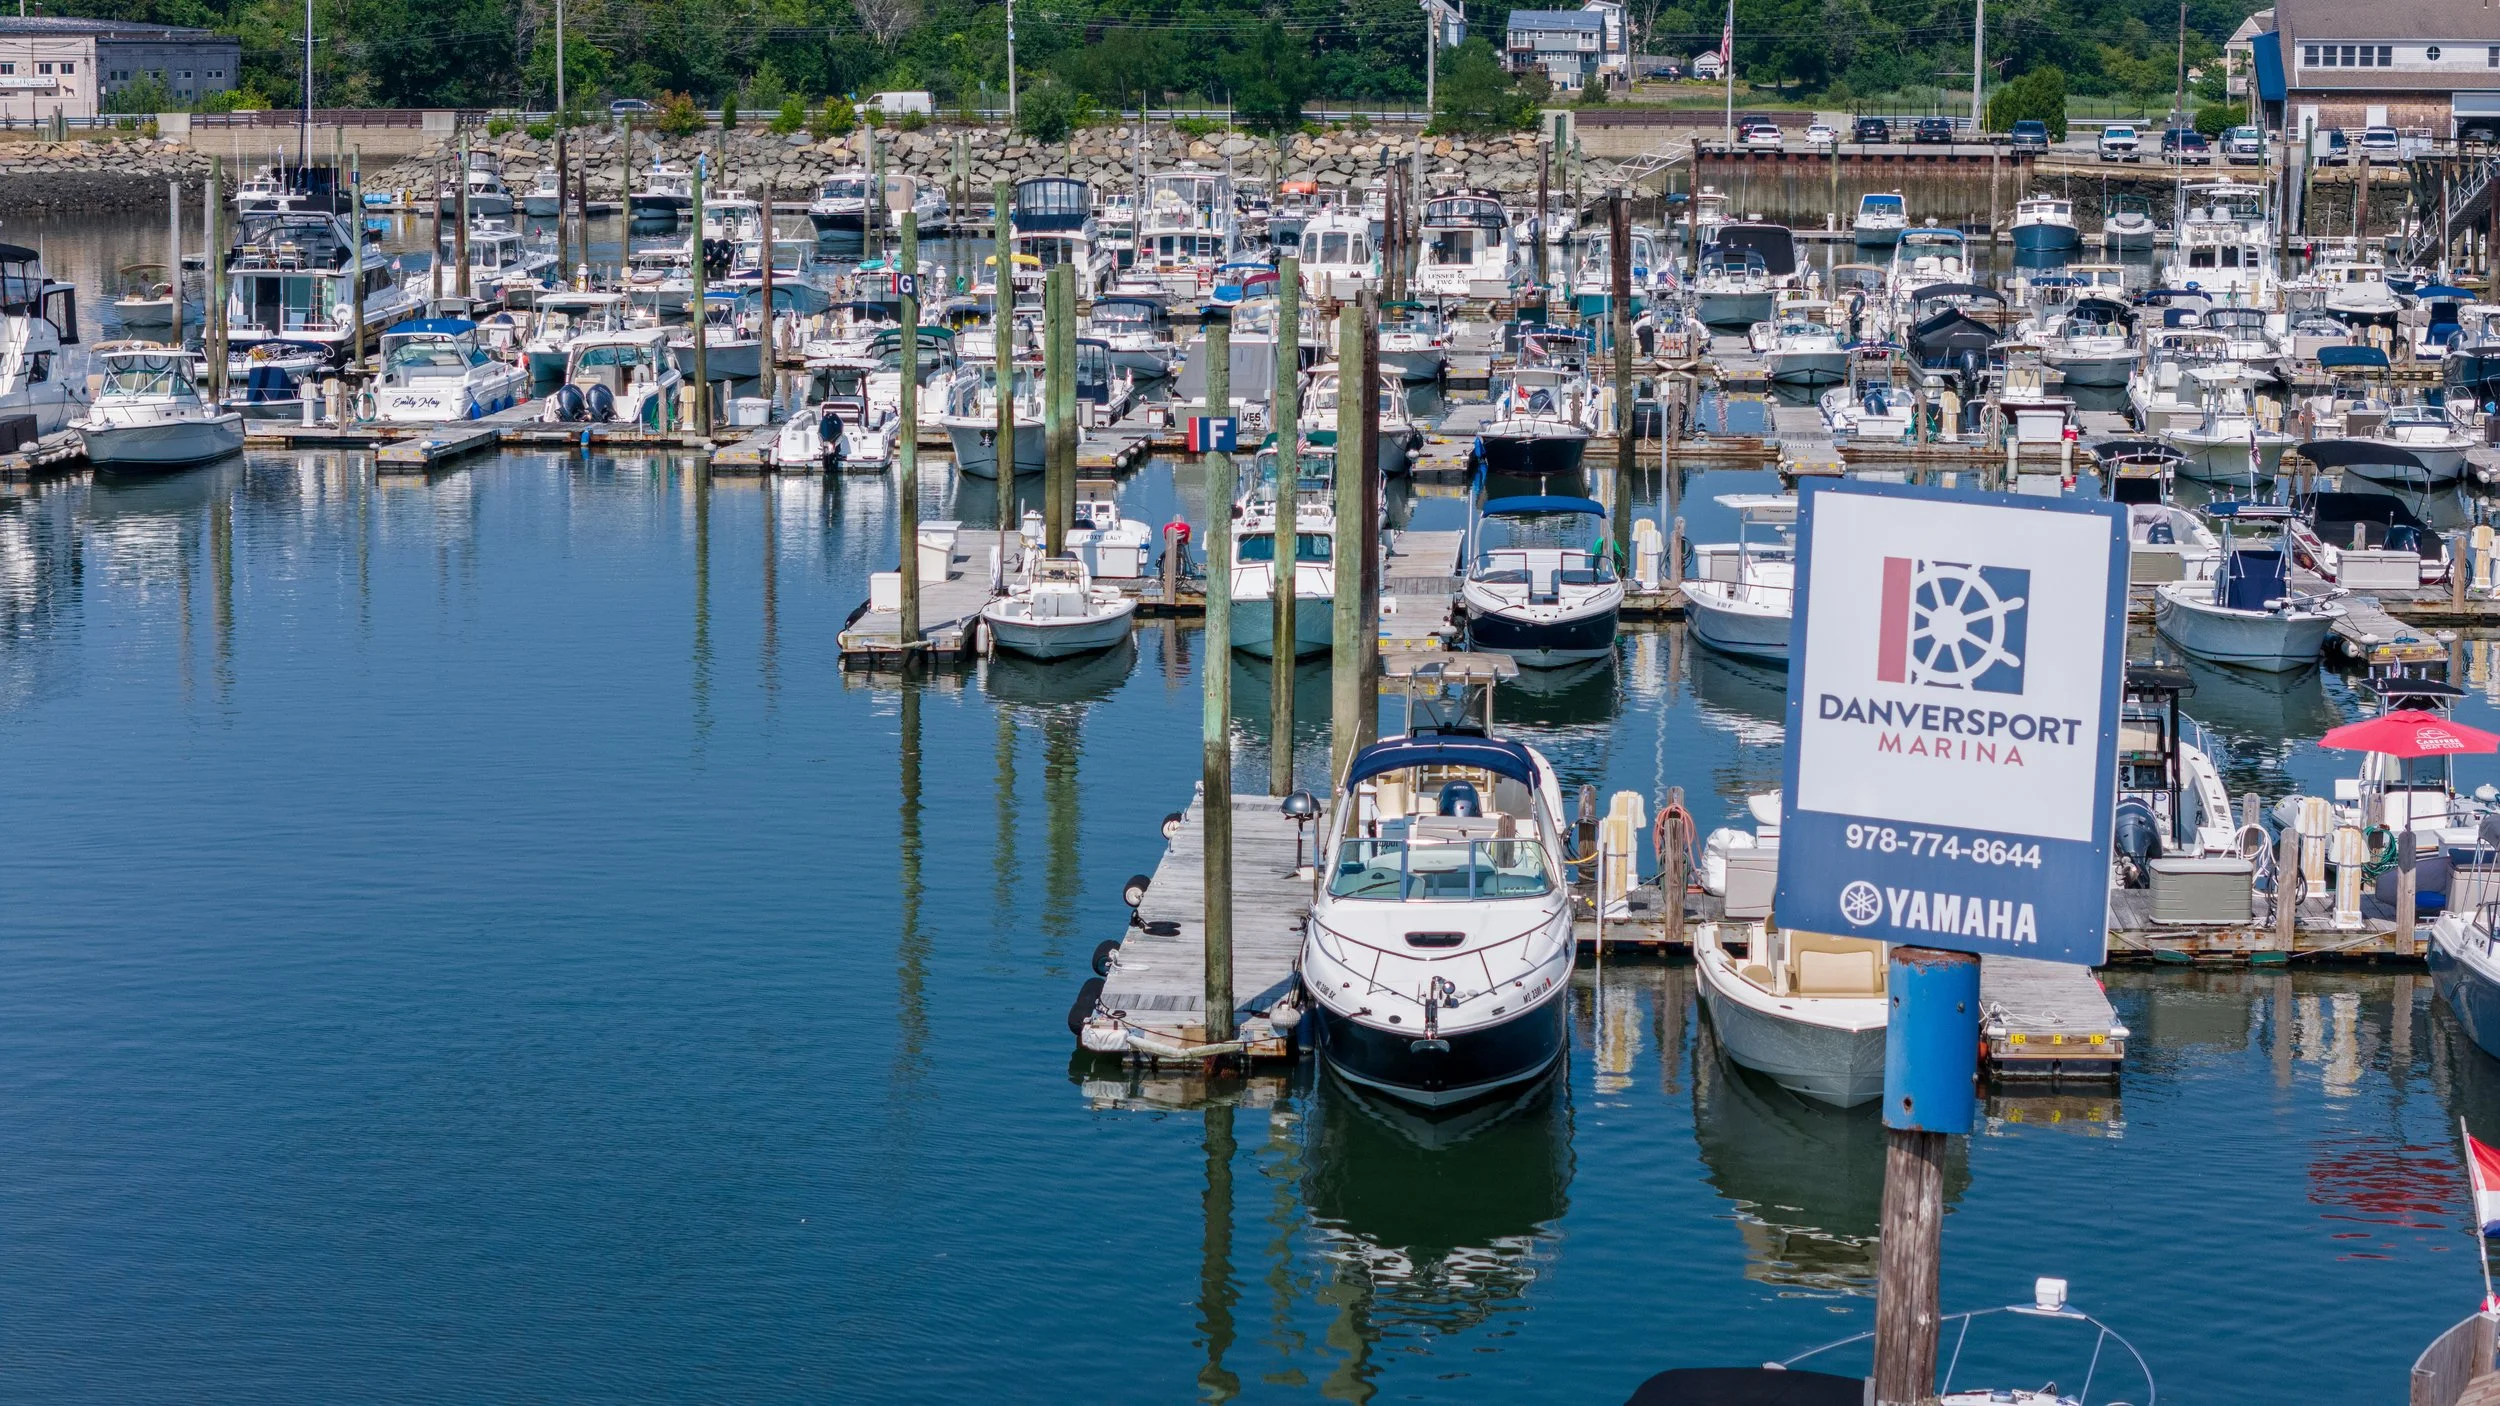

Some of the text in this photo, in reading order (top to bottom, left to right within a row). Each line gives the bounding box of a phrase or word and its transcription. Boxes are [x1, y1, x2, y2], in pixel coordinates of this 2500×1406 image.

[900, 274, 913, 293] G
[392, 396, 441, 408] Emily May
[1209, 419, 1229, 448] F
[1818, 693, 2082, 745] DANVERSPORT
[1877, 731, 2024, 767] MARINA
[1846, 823, 2042, 870] 978-774-8644
[1885, 886, 2038, 944] YAMAHA
[2012, 1034, 2025, 1044] 15
[2091, 1035, 2104, 1044] 13
